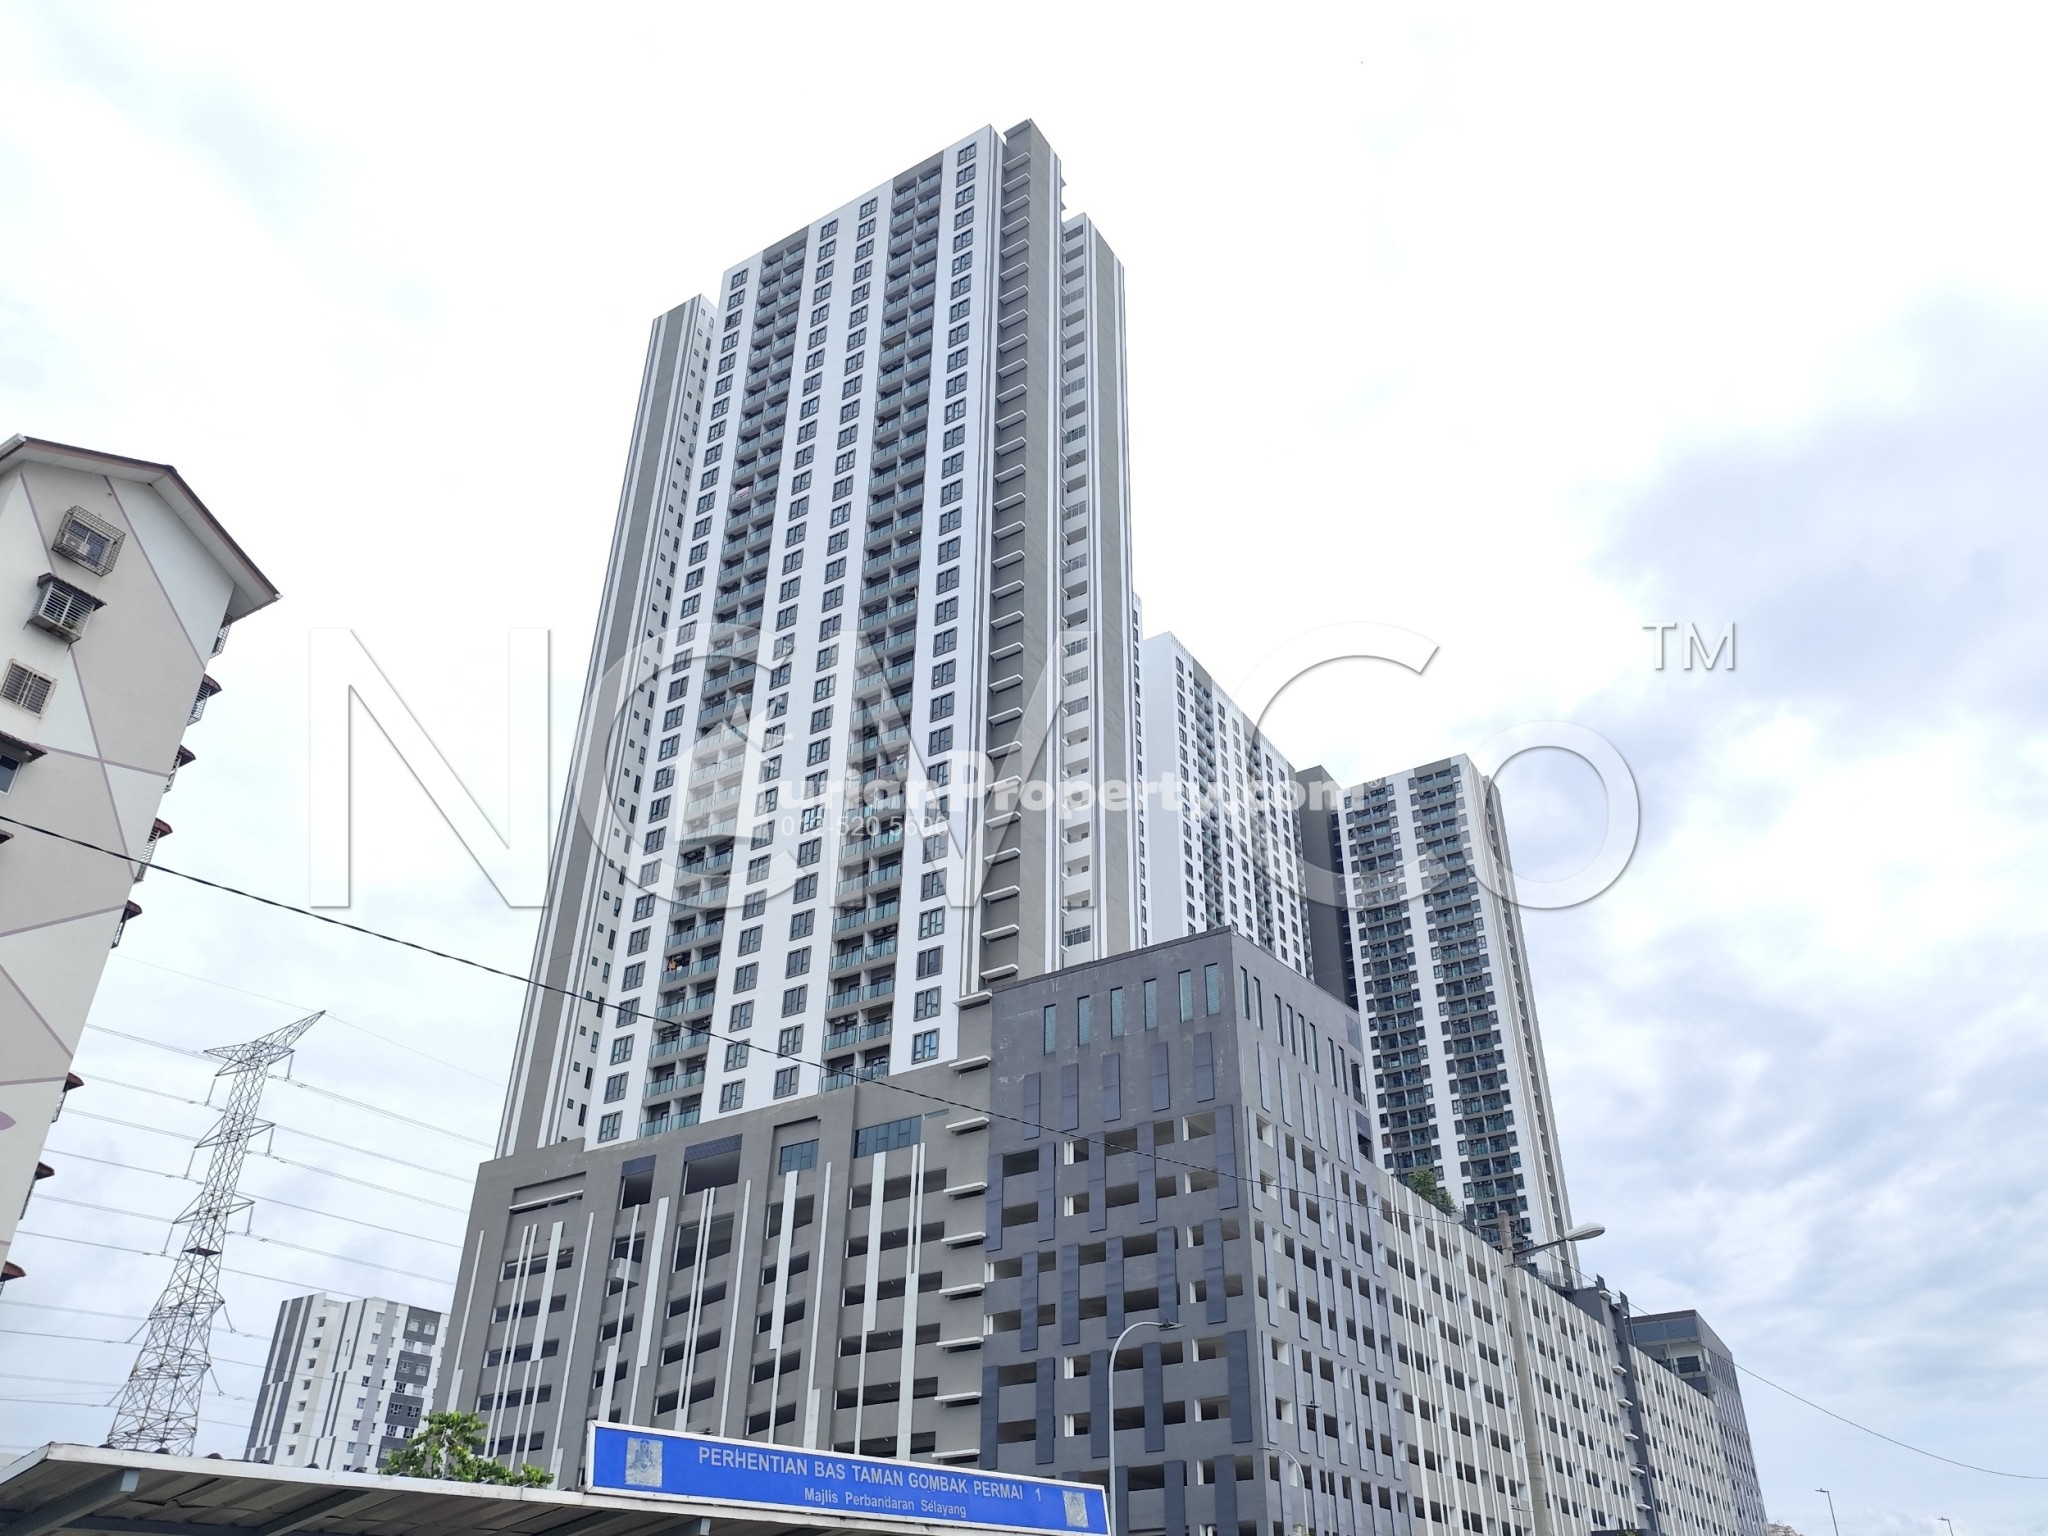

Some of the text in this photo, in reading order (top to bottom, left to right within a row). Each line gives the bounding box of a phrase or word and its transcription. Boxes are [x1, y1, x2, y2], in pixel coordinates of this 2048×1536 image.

[698, 1446, 1042, 1502] PERHENTIAN BAS TAMAN GOMBAK PERMAI 1
[804, 1487, 839, 1506] Majlis
[845, 1490, 915, 1511] Perbandaran
